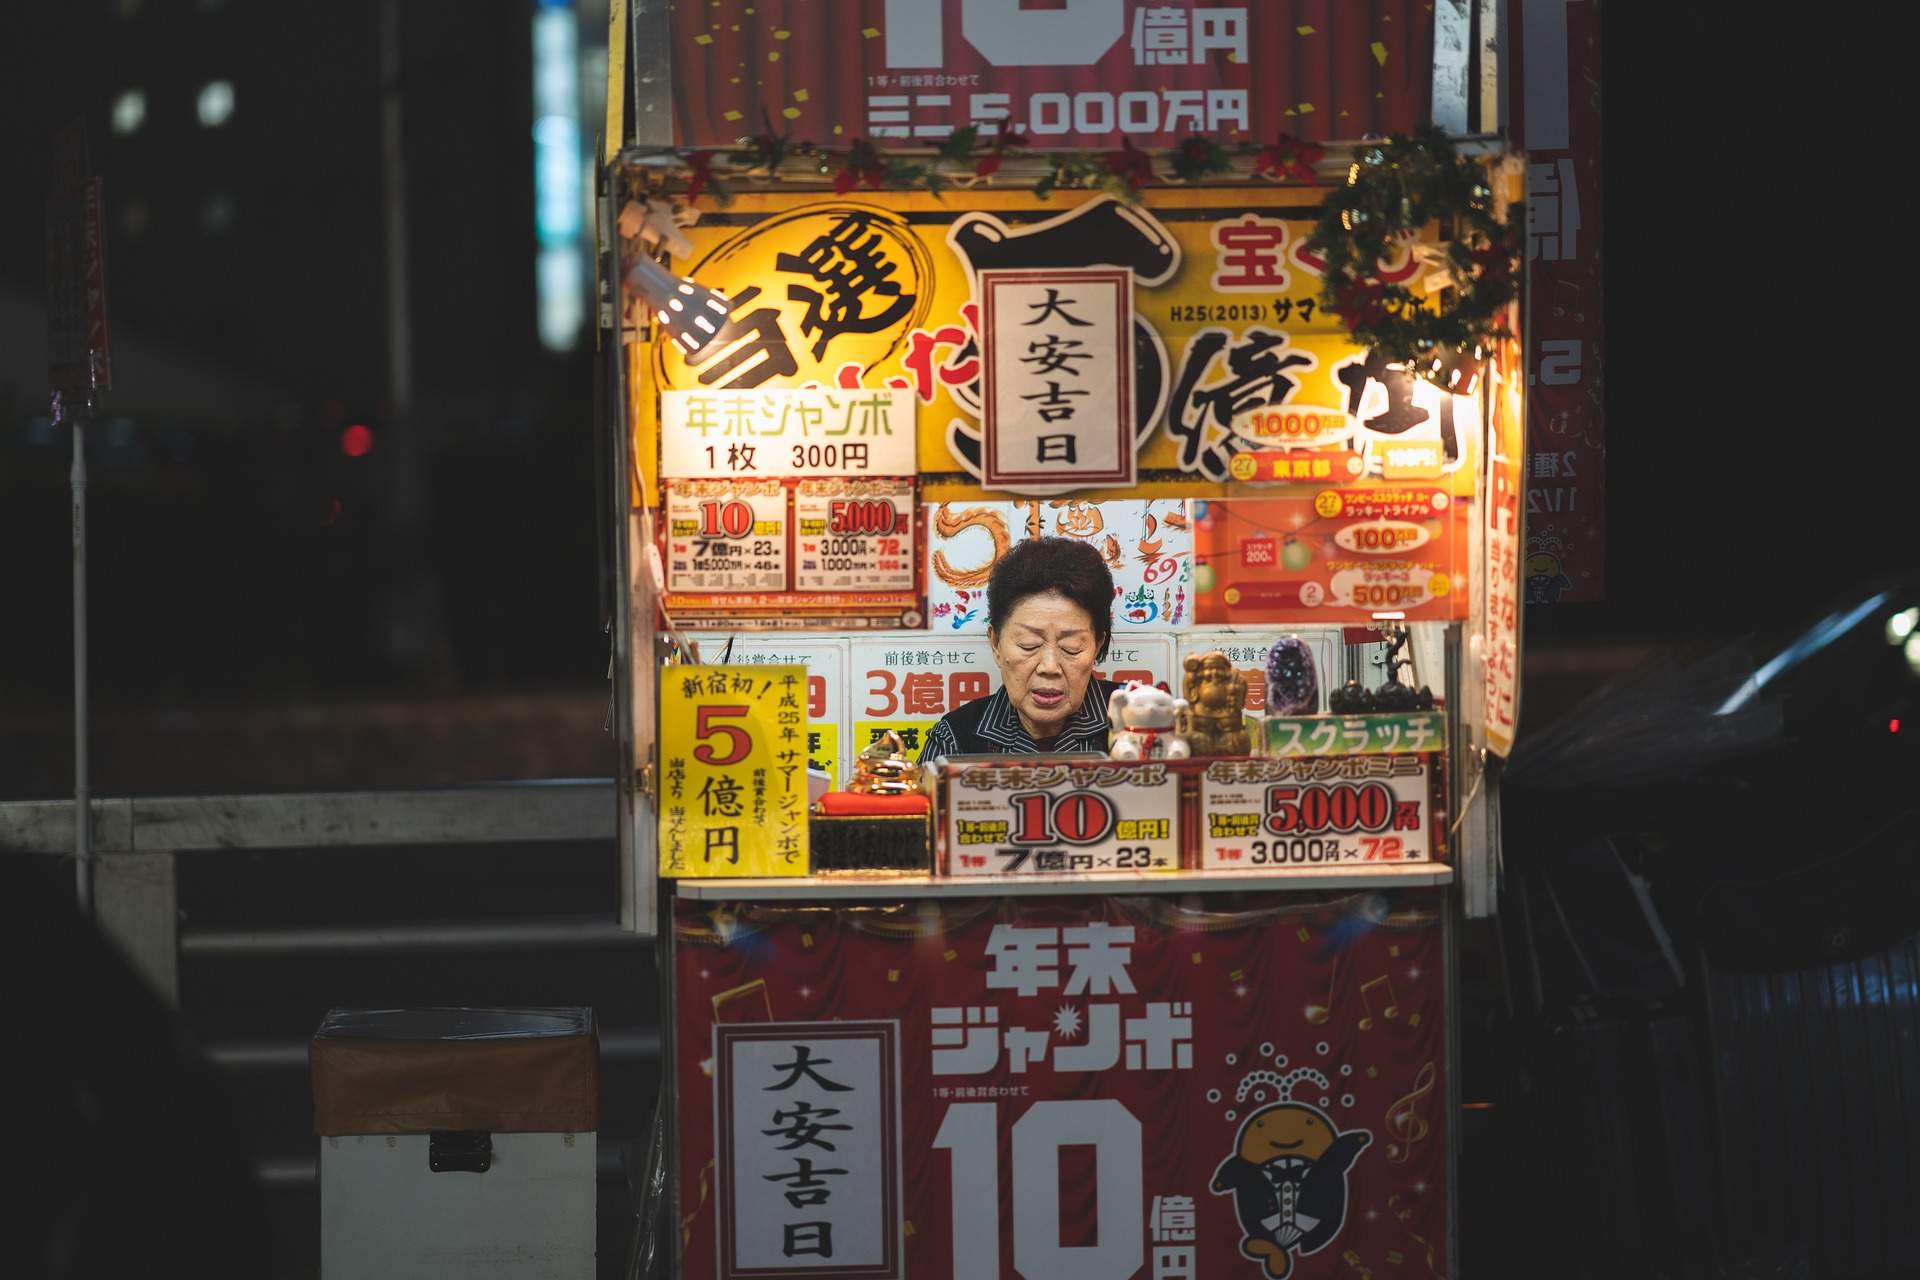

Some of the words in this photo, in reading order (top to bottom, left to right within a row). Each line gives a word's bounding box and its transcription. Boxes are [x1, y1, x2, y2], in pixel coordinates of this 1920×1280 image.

[1170, 305, 1268, 322] H25(2013)
[1273, 297, 1332, 324] サマ
[1018, 288, 1097, 465] 大安吉日
[685, 393, 893, 437] 年末ジャンボ
[705, 443, 757, 471] 1枚
[792, 443, 868, 470] 300円
[884, 650, 976, 666] 前後賞合せて
[681, 671, 772, 699] 新宿初!
[777, 674, 801, 743] 平成25年
[1278, 718, 1435, 753] スクラッチ
[961, 763, 1168, 791] 年末ジャンボ
[1207, 757, 1423, 784] 年末ジャンボミニ
[984, 921, 1137, 996] 年末
[931, 1002, 1193, 1076] ジャンボ
[761, 1045, 856, 1259] 大安吉日
